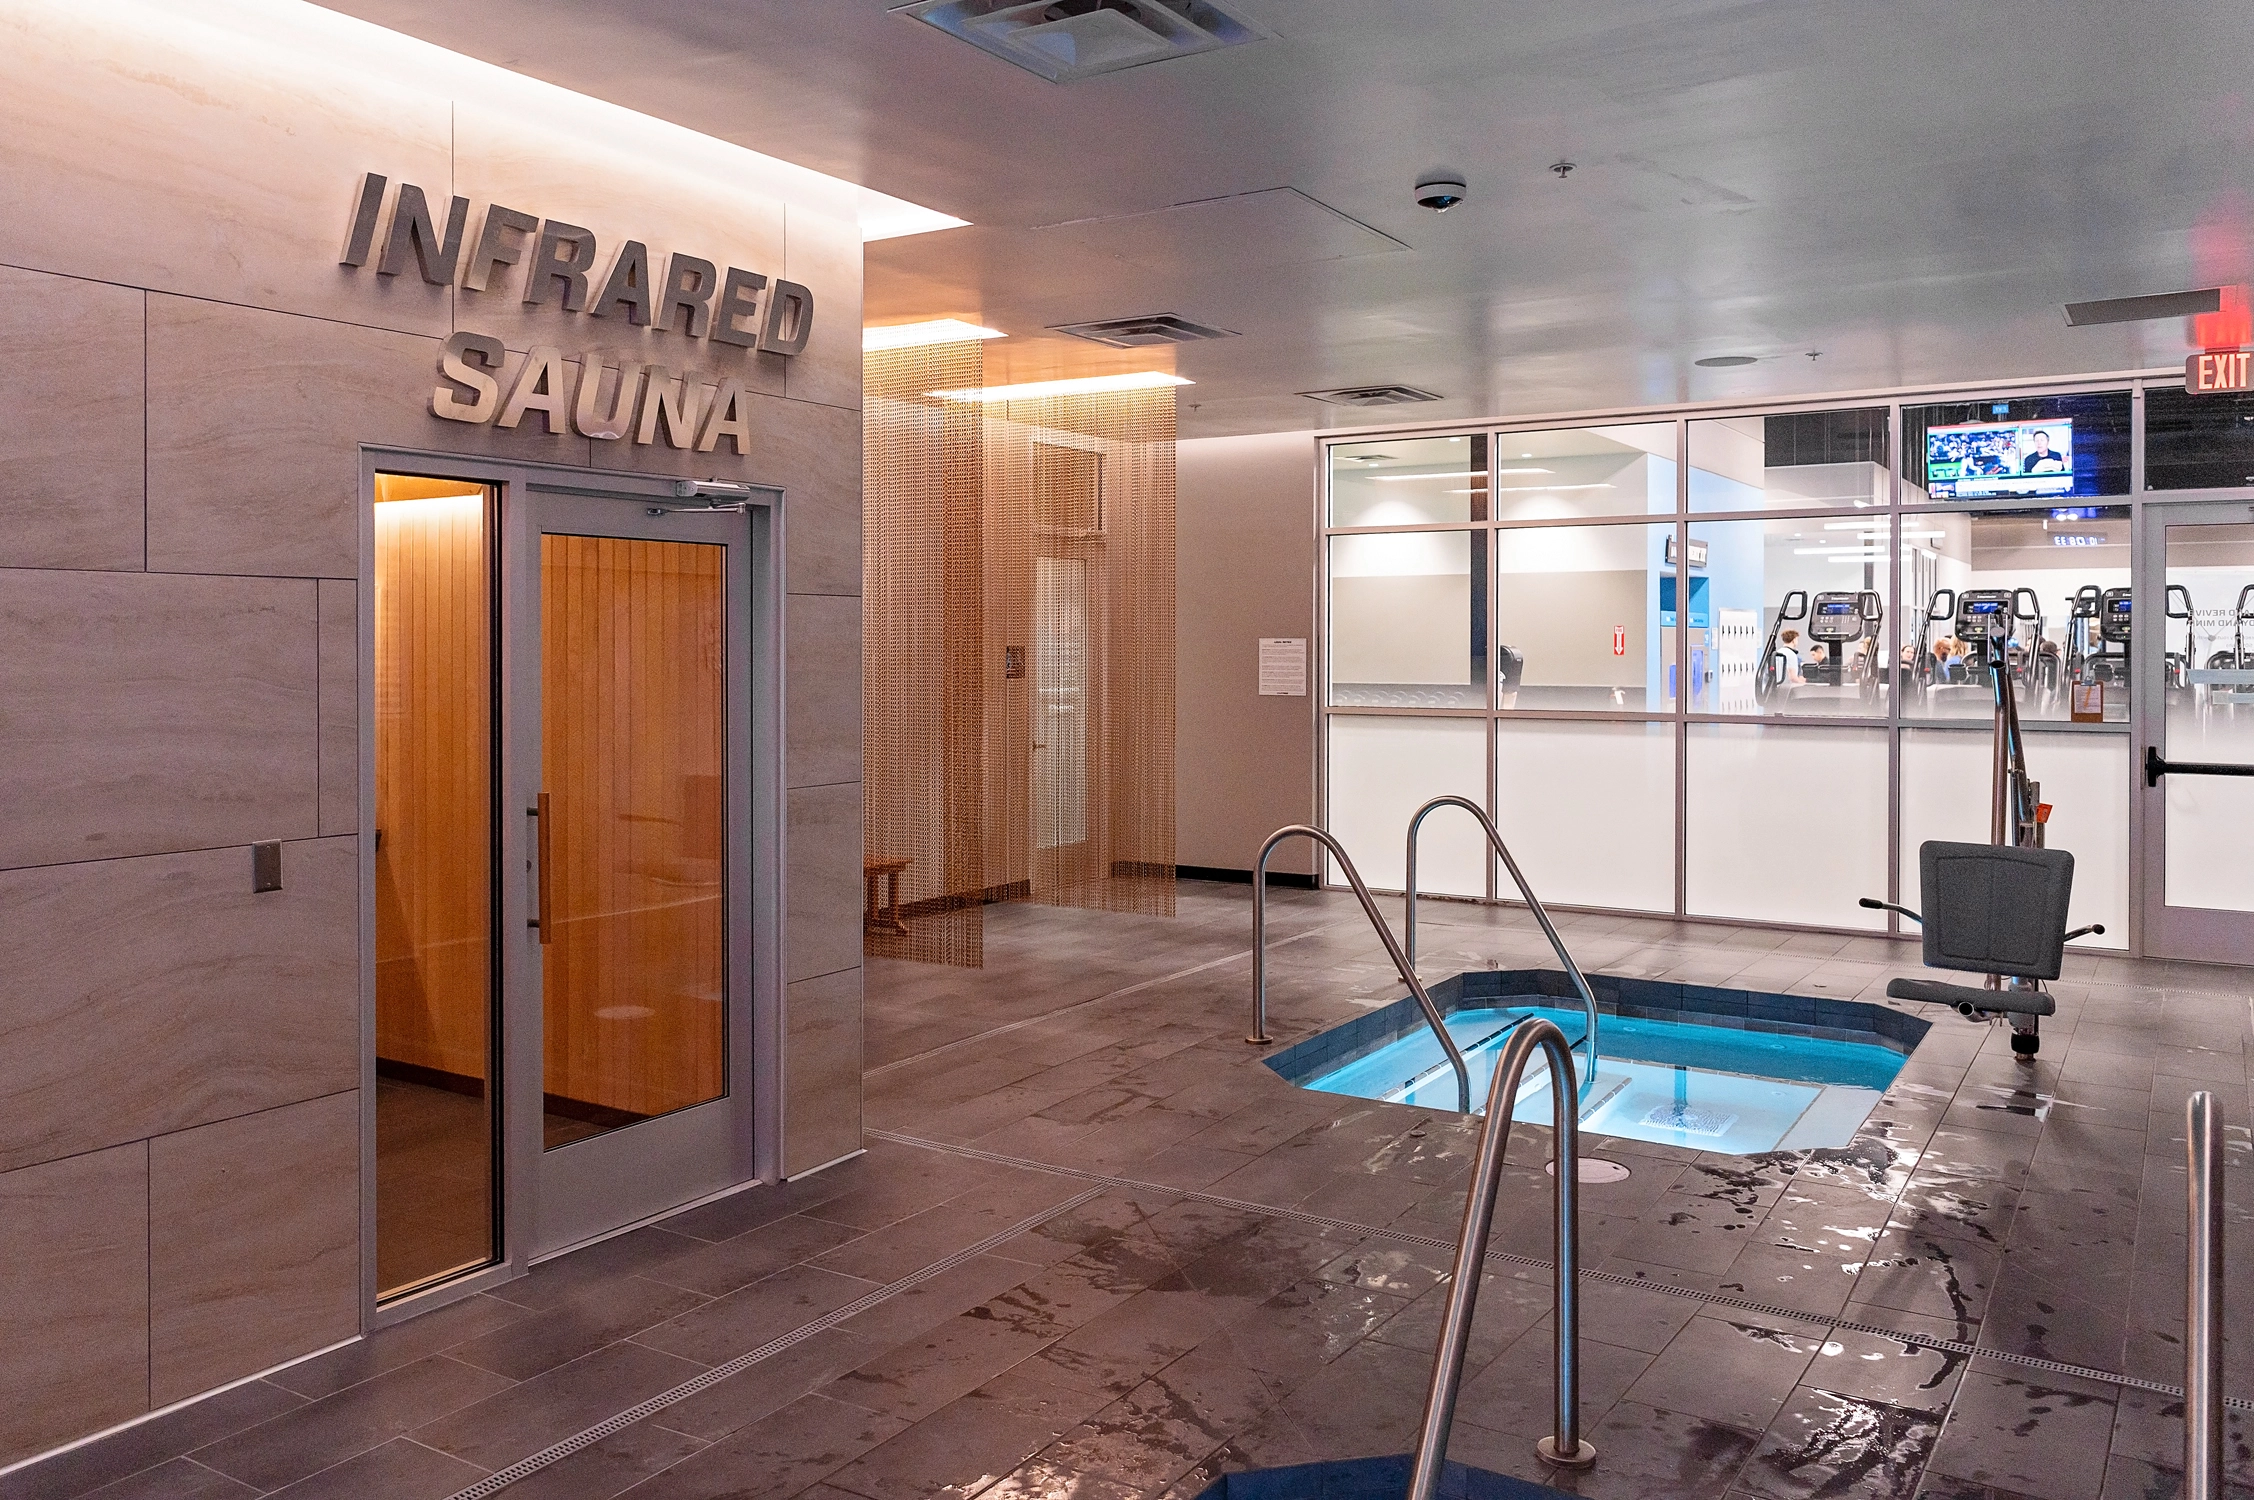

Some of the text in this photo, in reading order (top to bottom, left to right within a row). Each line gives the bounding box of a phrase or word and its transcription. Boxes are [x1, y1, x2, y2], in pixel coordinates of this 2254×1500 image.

[339, 172, 815, 356] INFRARED
[428, 331, 751, 455] SAUNA
[2198, 352, 2251, 390] EXIT
